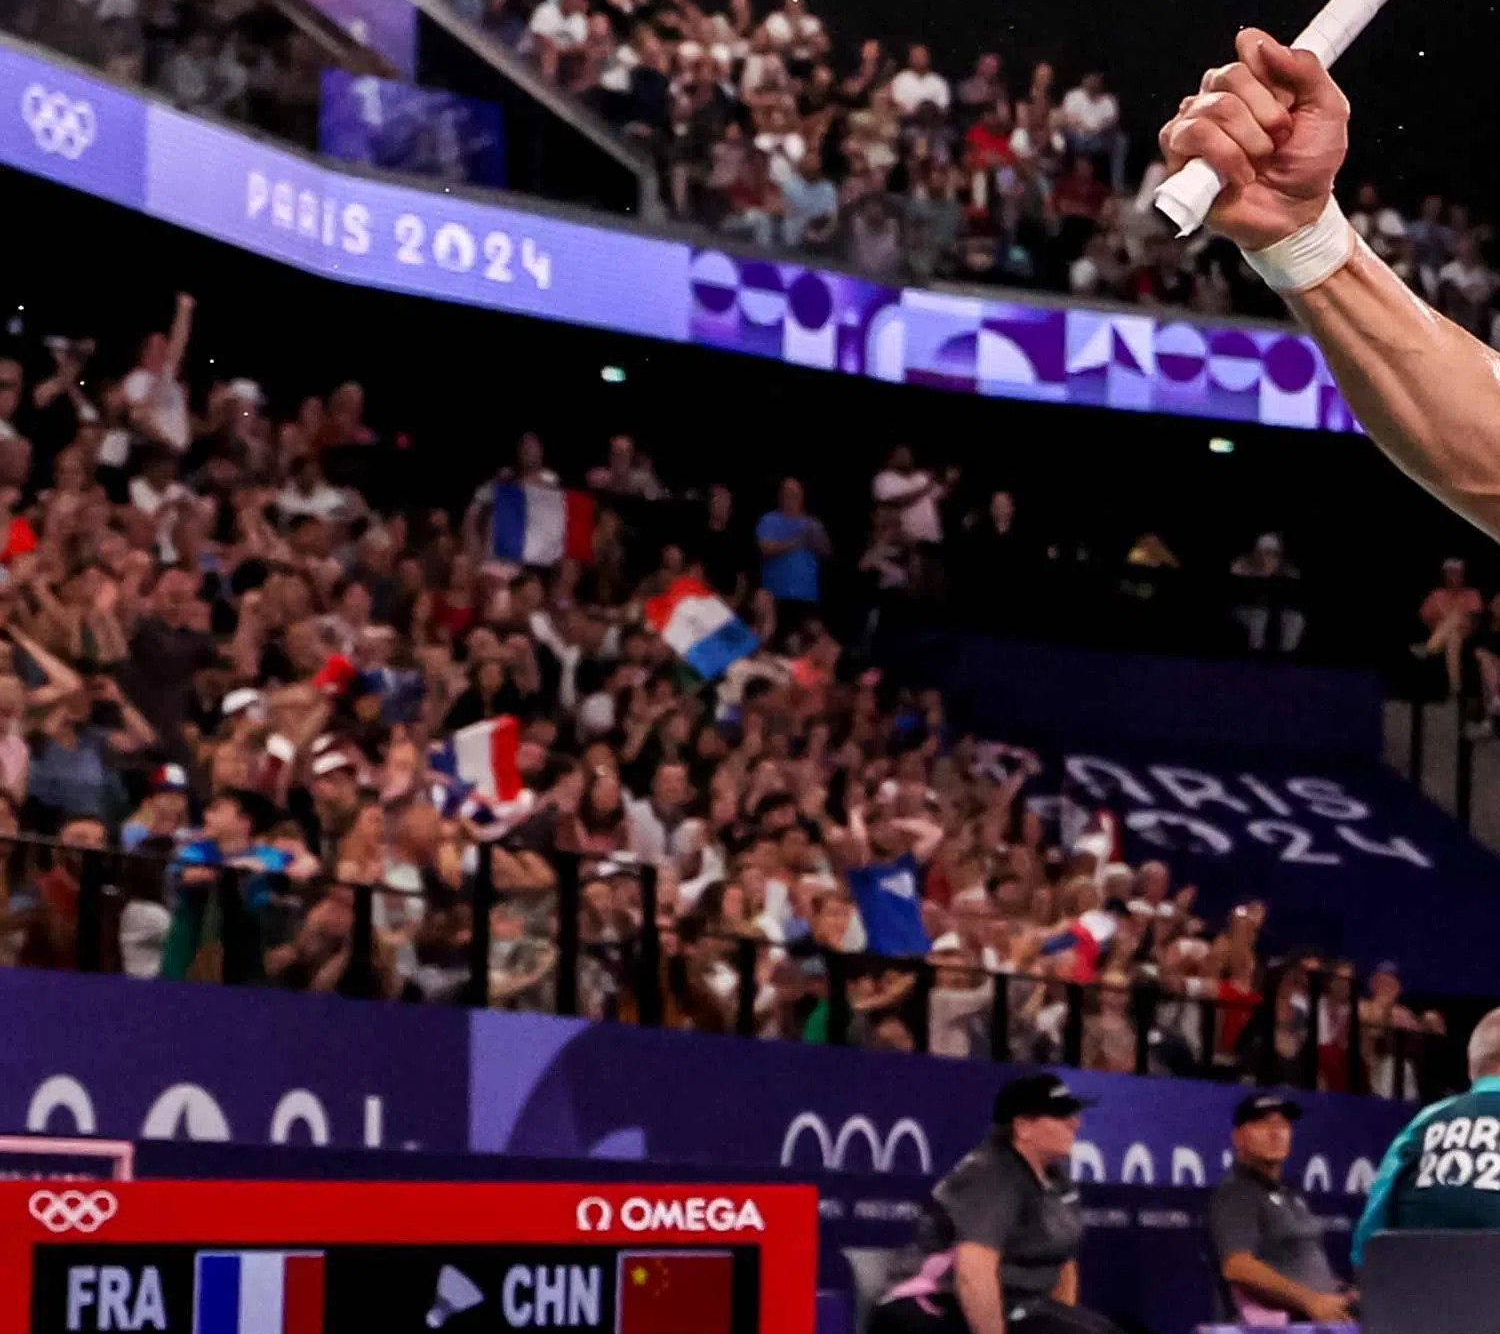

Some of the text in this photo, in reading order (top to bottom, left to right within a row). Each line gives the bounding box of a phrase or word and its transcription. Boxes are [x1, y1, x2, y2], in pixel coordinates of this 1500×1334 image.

[247, 170, 550, 290] PARIS 2024
[621, 1196, 765, 1232] OMEGA
[66, 1265, 167, 1331] FRA
[502, 1264, 601, 1328] CHN
